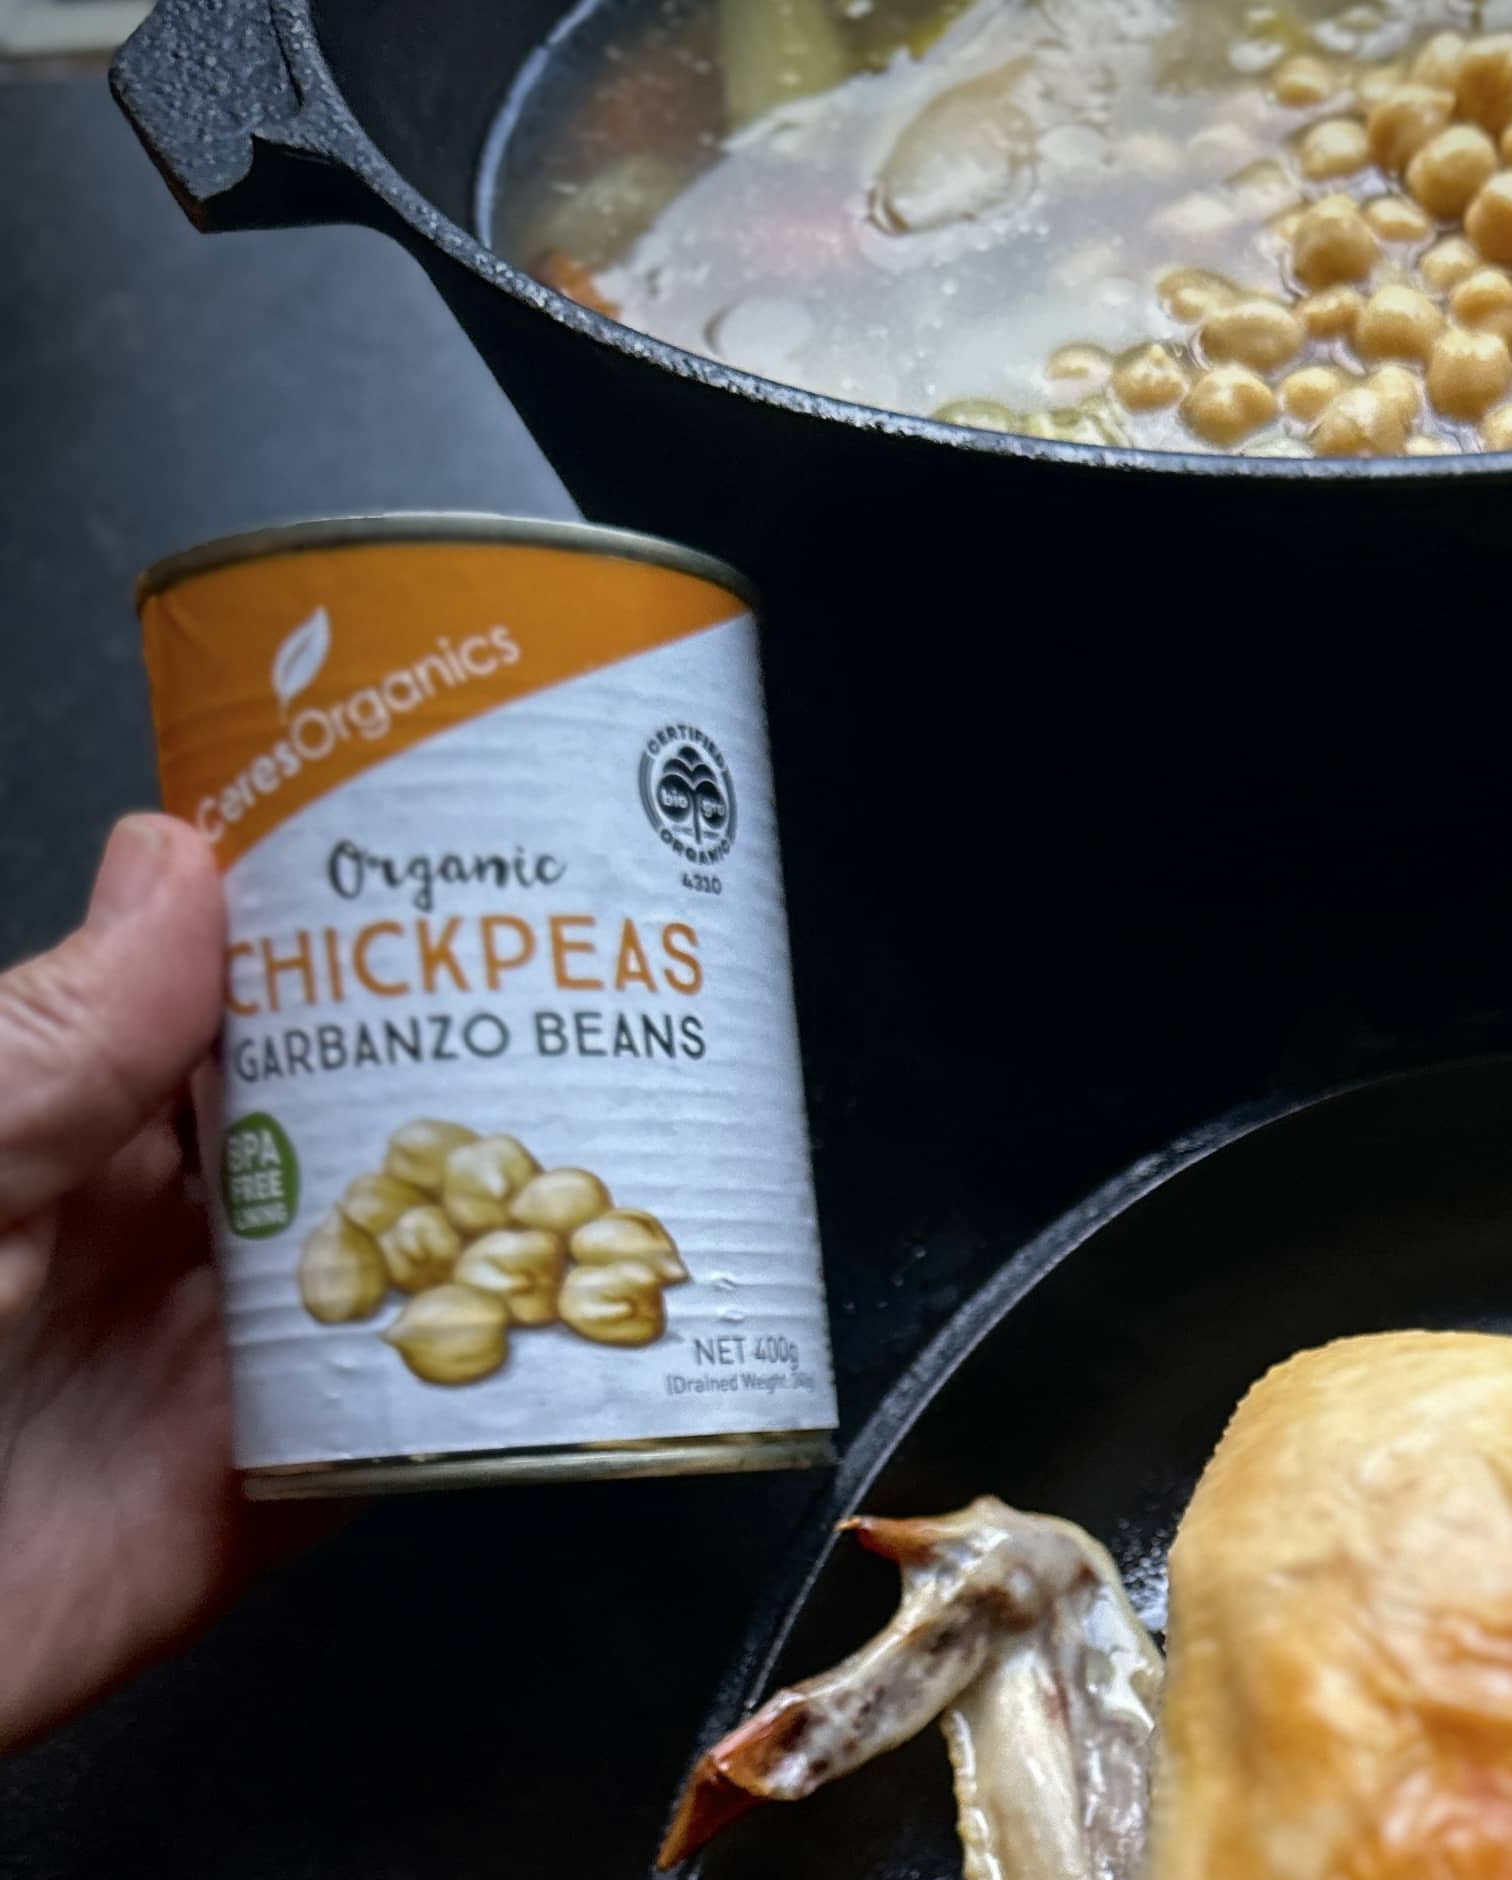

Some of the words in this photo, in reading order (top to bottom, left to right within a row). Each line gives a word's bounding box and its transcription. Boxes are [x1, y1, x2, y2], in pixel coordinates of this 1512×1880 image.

[648, 724, 725, 770] CERTIFIED
[659, 827, 731, 865] ORGANIC
[327, 839, 567, 913] Organic
[226, 914, 703, 1017] CHICKPEAS
[234, 1012, 511, 1083] GARBANZO
[534, 1010, 707, 1060] BEANS
[694, 1335, 745, 1366] NET
[754, 1335, 799, 1371] 400g
